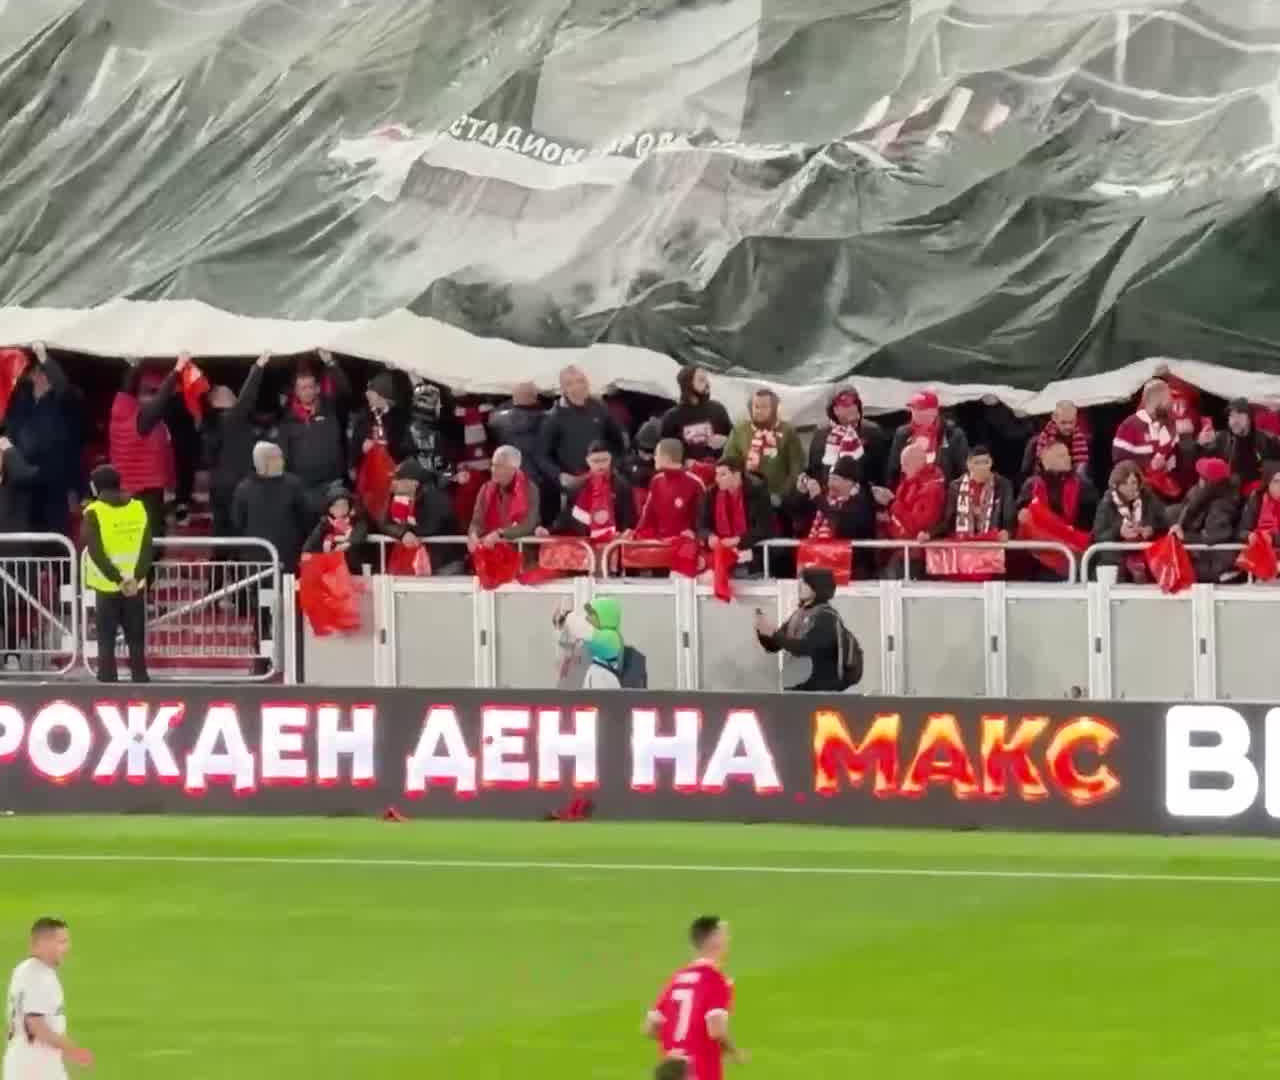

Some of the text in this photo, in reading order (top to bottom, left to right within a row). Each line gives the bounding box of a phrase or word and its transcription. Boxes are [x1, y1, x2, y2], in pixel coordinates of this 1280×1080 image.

[405, 704, 600, 796] ДЕН
[629, 707, 783, 793] НА
[813, 709, 1120, 806] МАКС
[671, 988, 695, 1043] 7
